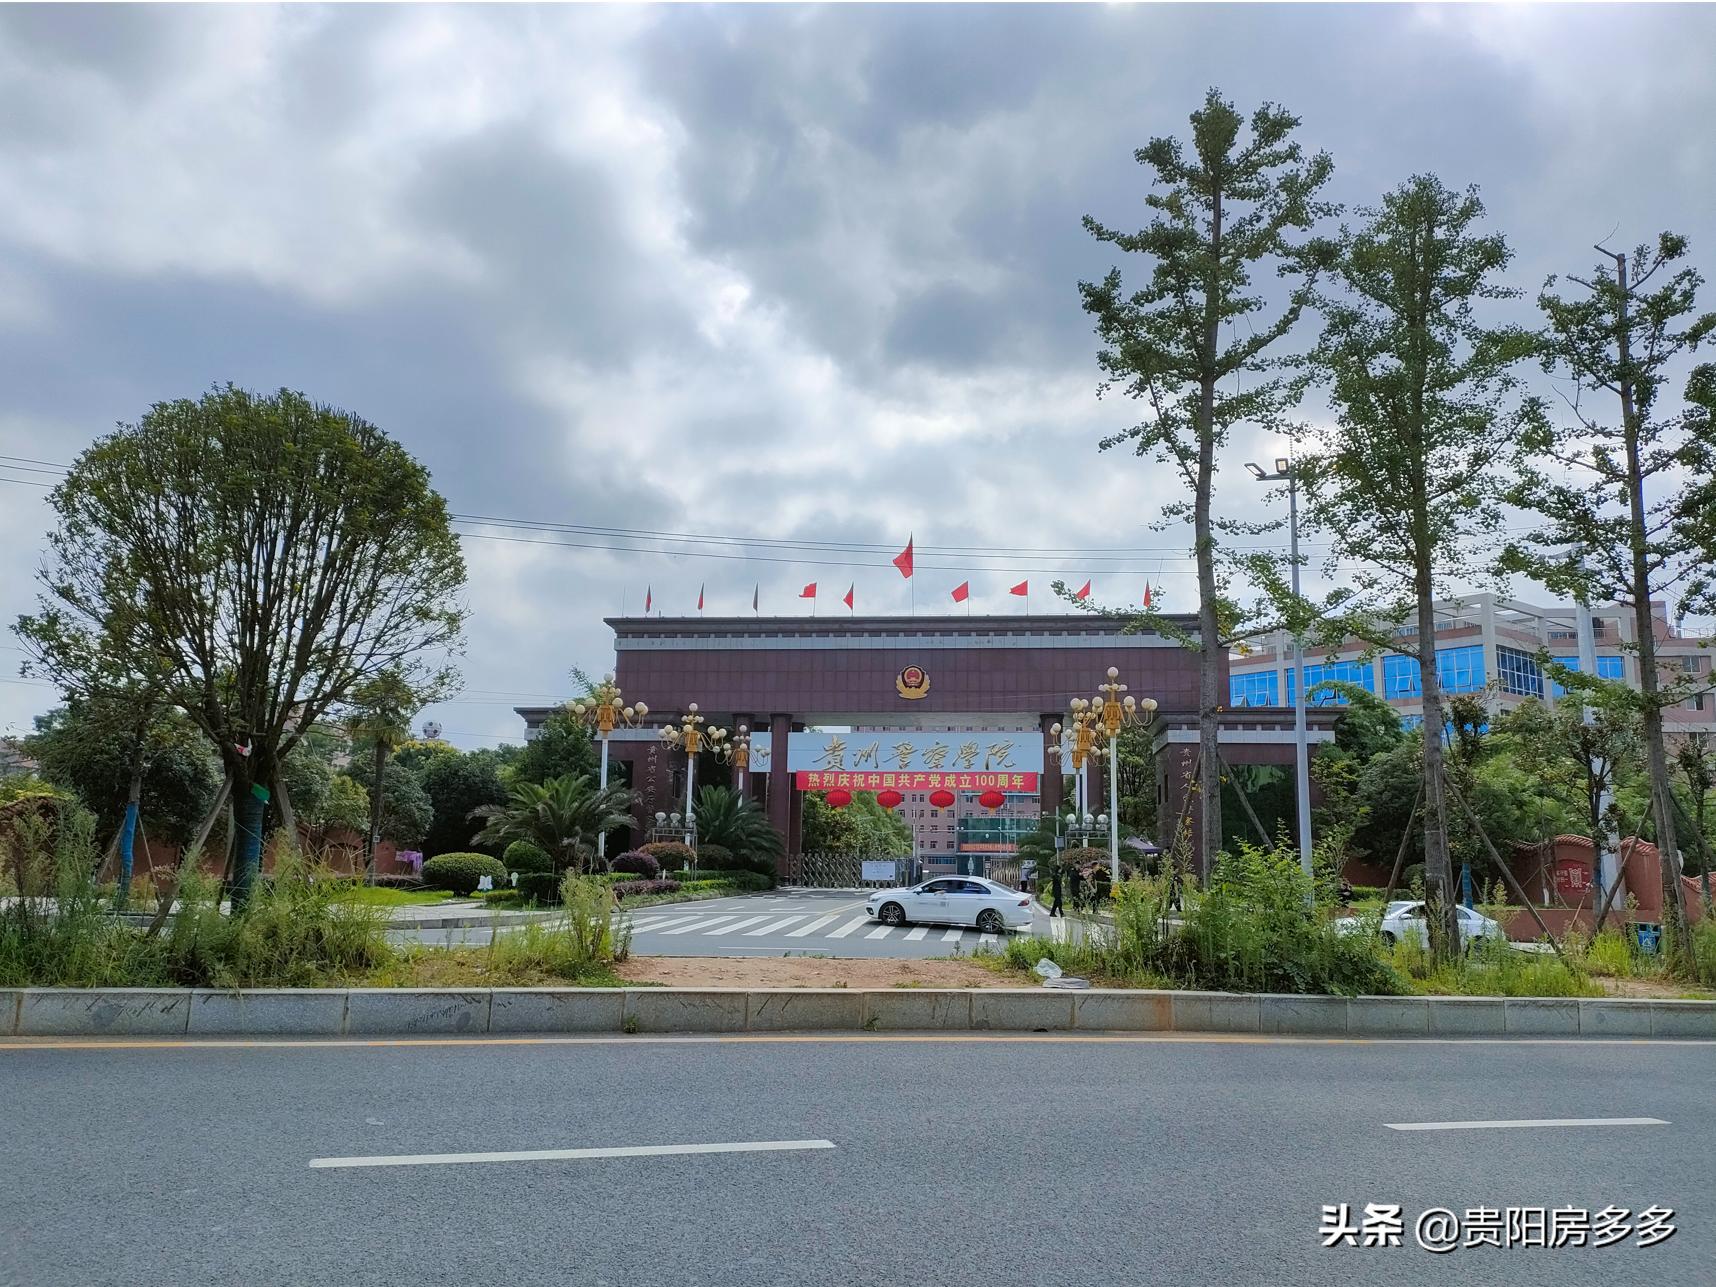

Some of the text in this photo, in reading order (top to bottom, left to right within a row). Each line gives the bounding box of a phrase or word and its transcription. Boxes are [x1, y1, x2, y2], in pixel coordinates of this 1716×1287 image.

[807, 773, 1025, 788] 热烈庆祝中国共产党成立100周年
